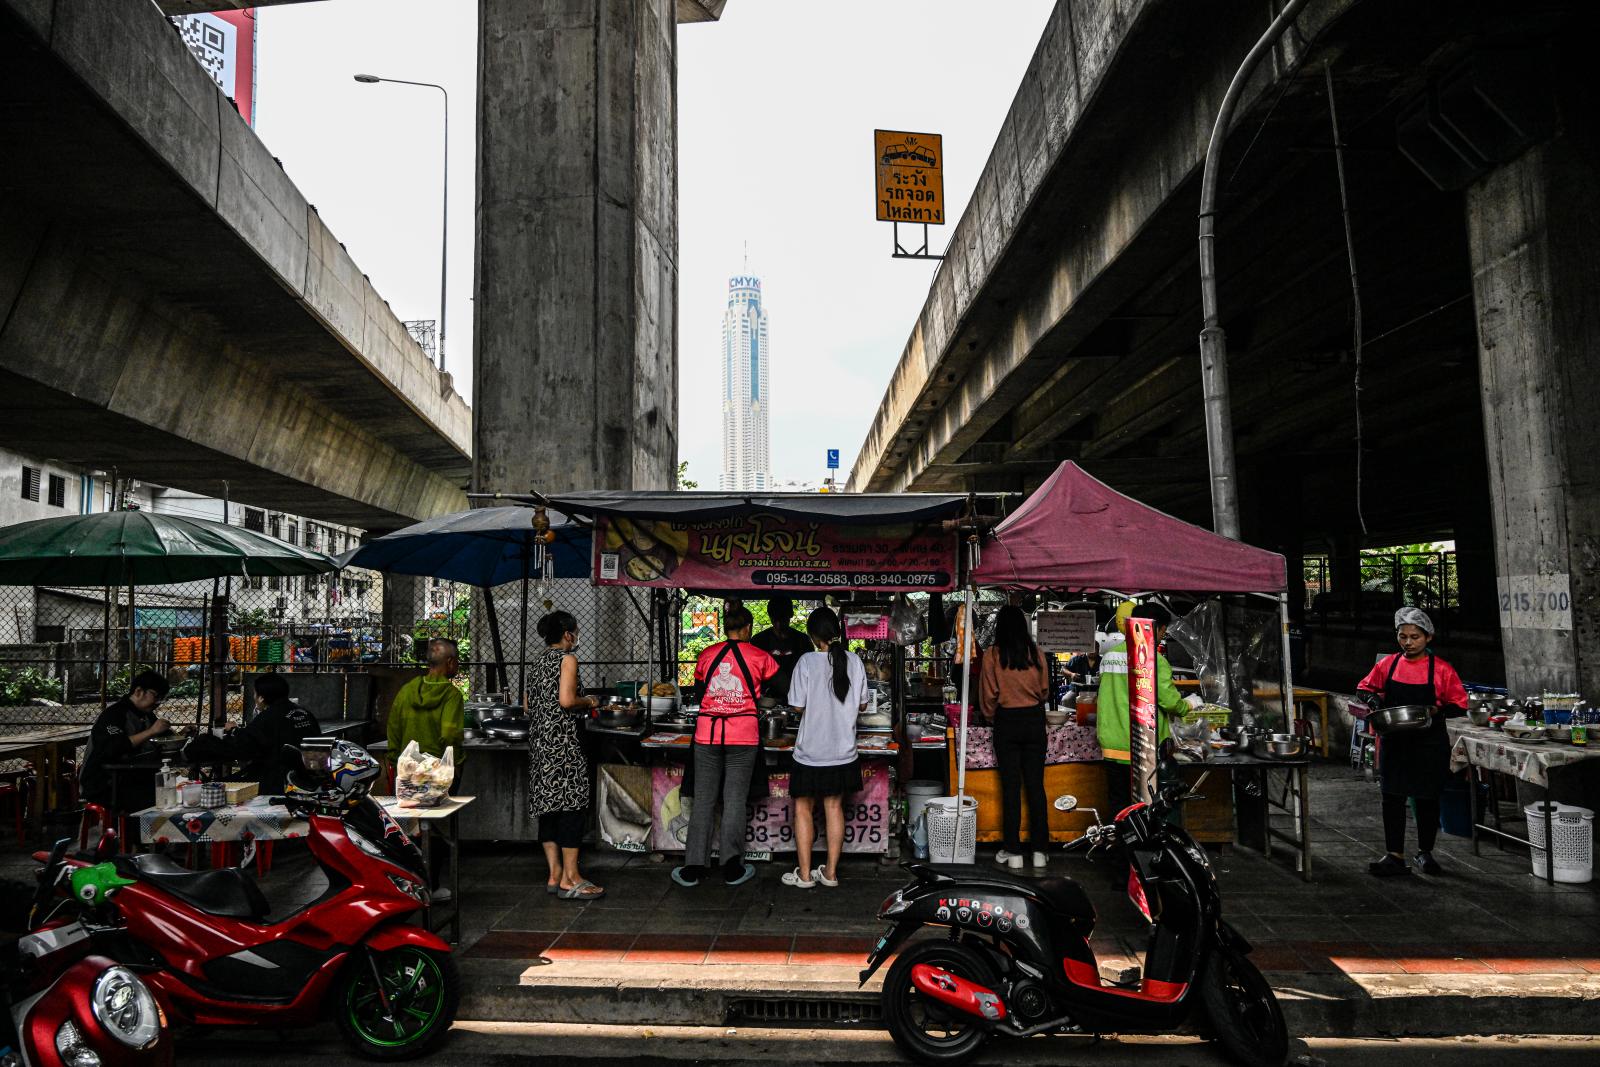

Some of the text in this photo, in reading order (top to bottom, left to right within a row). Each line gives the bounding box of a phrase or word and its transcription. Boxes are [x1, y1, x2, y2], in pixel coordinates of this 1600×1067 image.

[893, 169, 927, 186] ระวัง
[886, 188, 935, 202] รถจอด
[881, 199, 941, 221] ไหล่ทาง
[729, 276, 760, 288] CMYK
[766, 572, 936, 586] 095-142-0583, 083-940-0975
